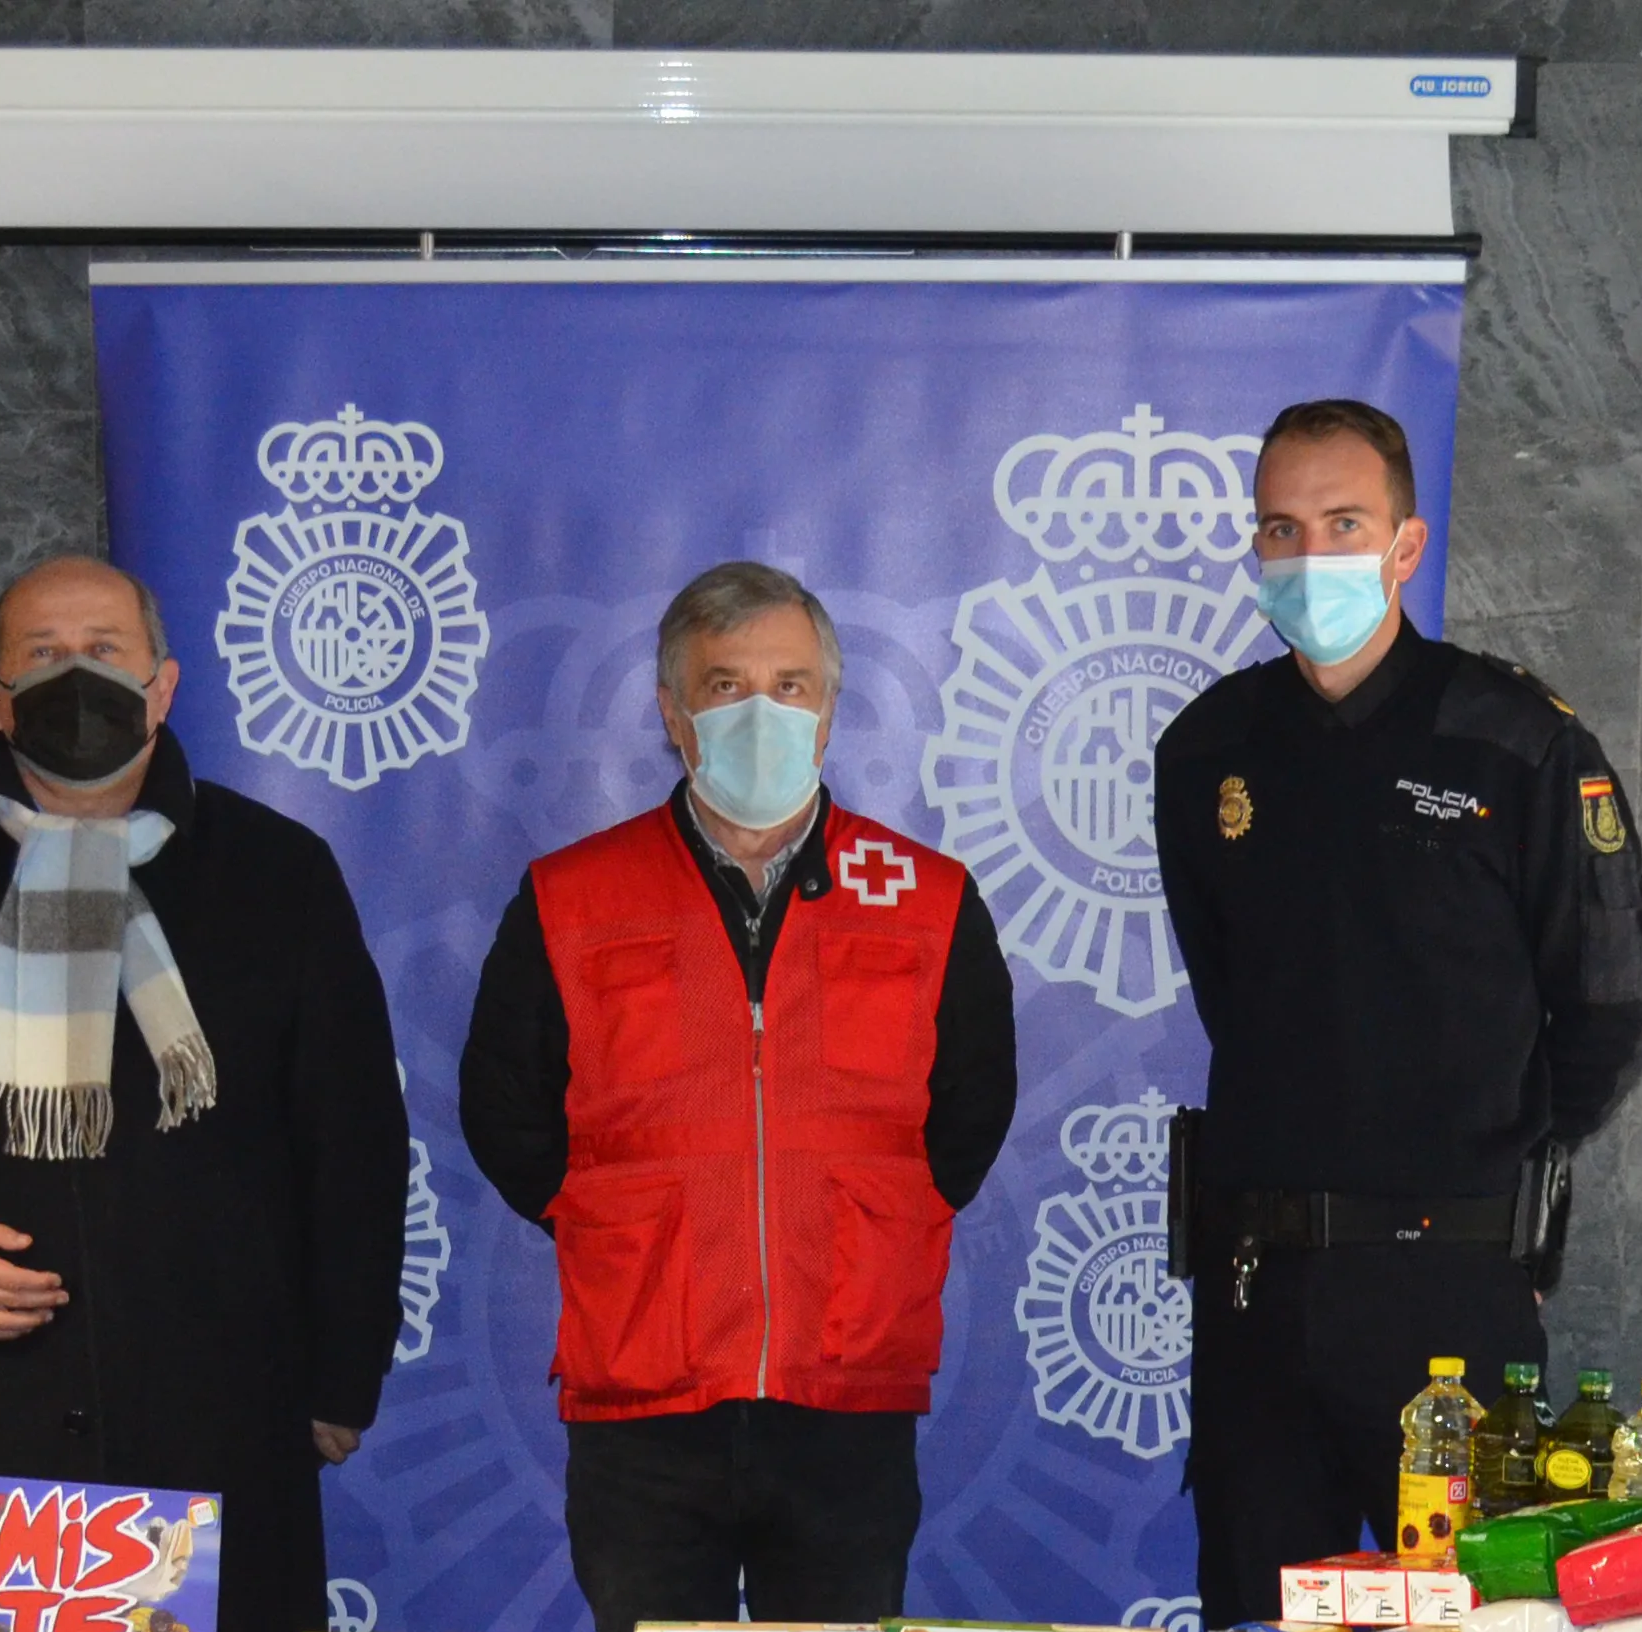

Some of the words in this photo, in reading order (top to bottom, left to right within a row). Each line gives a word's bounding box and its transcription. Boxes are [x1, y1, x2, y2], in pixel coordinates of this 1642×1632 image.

[280, 563, 331, 618] CUERPO
[334, 558, 409, 601] NACIONAL
[406, 598, 426, 621] DE
[324, 694, 385, 712] POLICIA
[1024, 660, 1106, 745] CUERPO
[1415, 800, 1461, 820] CNP
[1120, 1366, 1179, 1384] POLICIA
